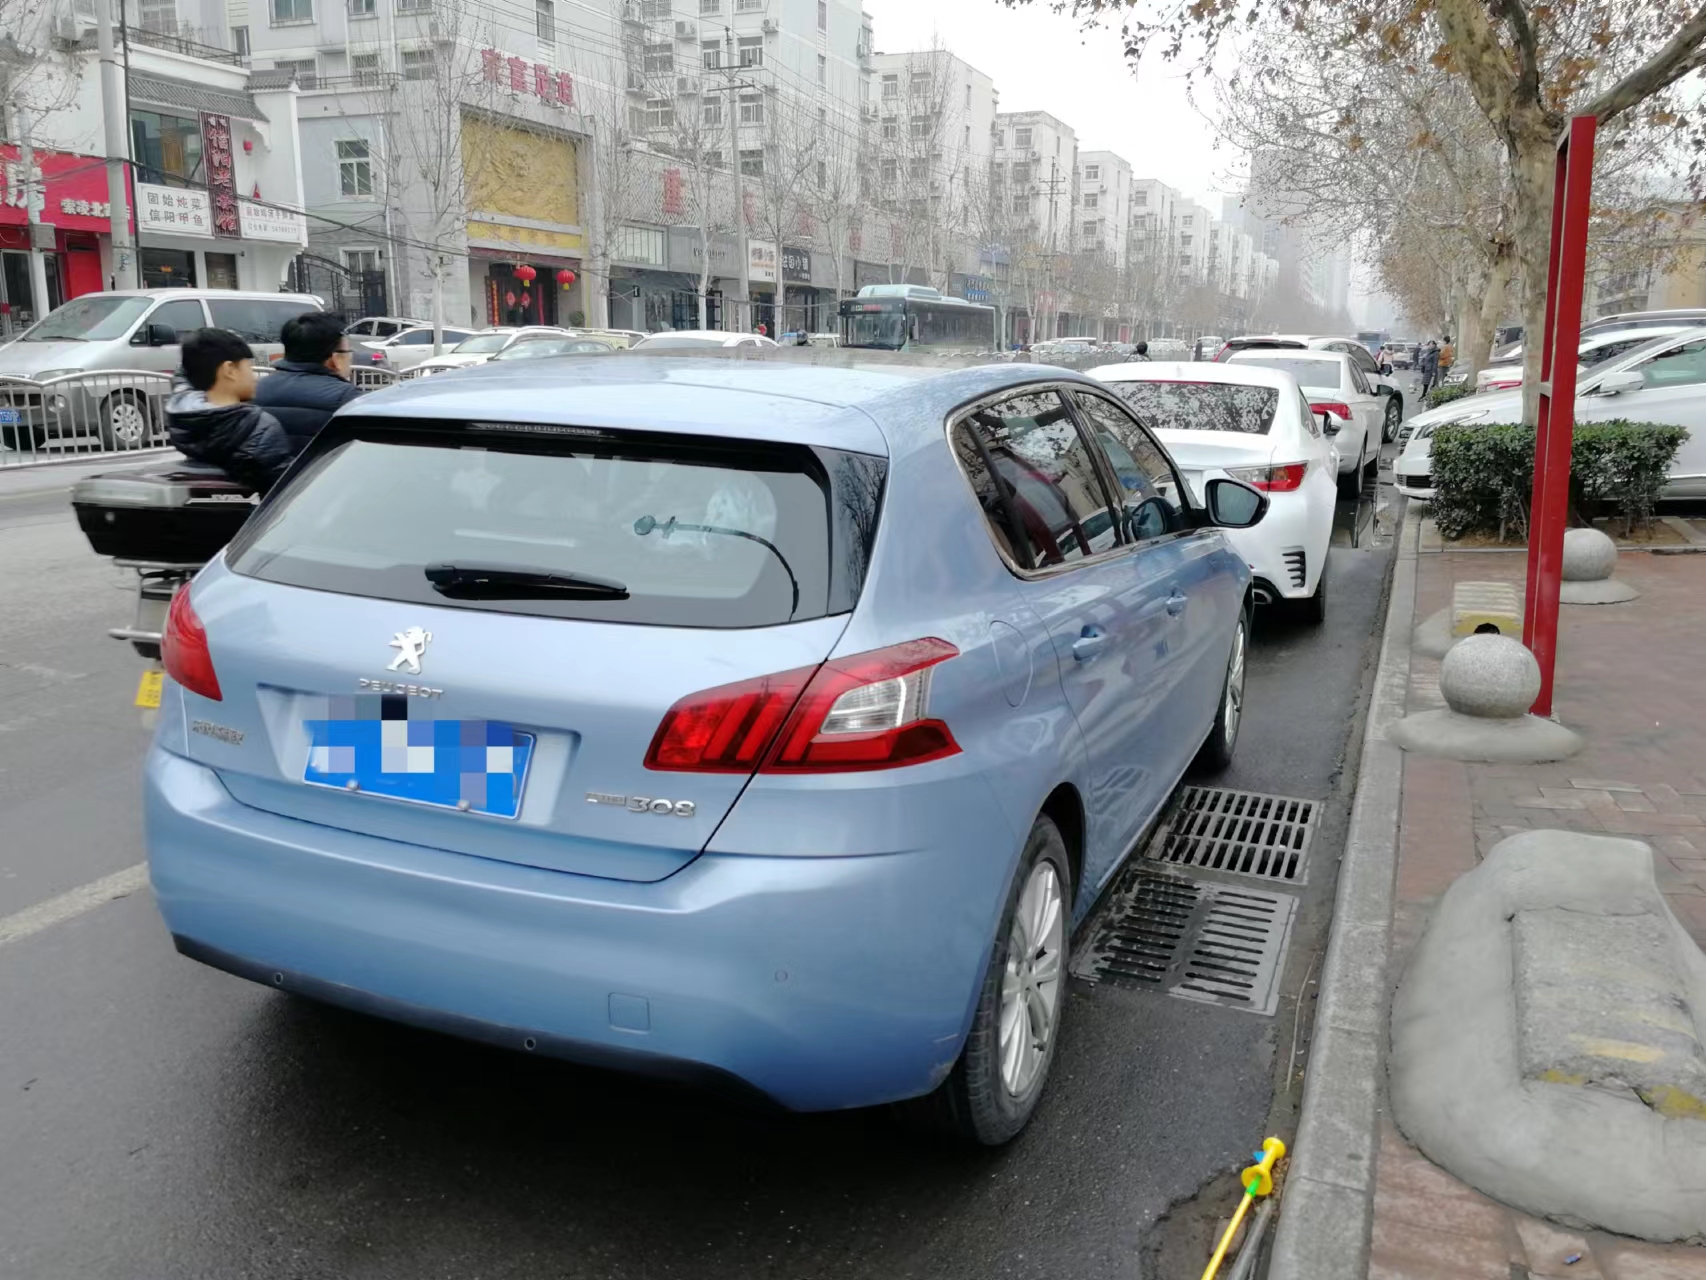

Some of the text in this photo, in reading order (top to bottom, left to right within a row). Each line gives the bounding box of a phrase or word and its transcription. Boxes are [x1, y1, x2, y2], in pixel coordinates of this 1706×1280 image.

[147, 192, 202, 210] 固始炖菜
[149, 208, 204, 227] 信阳甲鱼
[359, 678, 444, 699] PEUGEOT
[627, 796, 696, 818] 308
